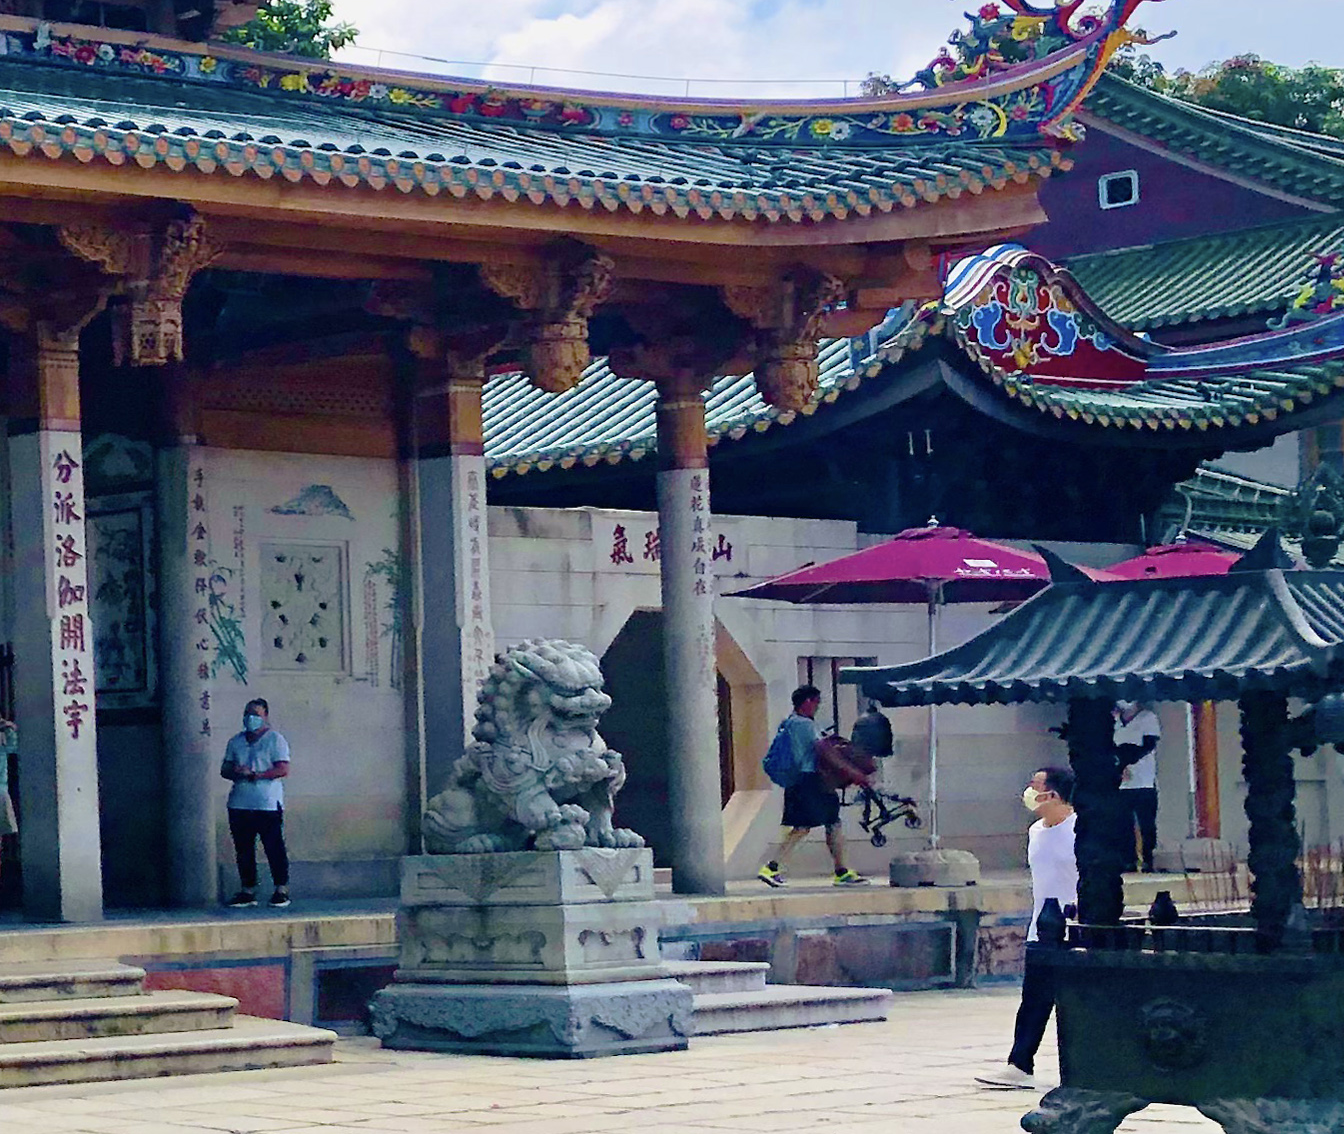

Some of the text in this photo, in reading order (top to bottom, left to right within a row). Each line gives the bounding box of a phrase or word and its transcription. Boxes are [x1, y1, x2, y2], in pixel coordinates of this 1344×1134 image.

[52, 449, 89, 740] 分派洛伽開法宇
